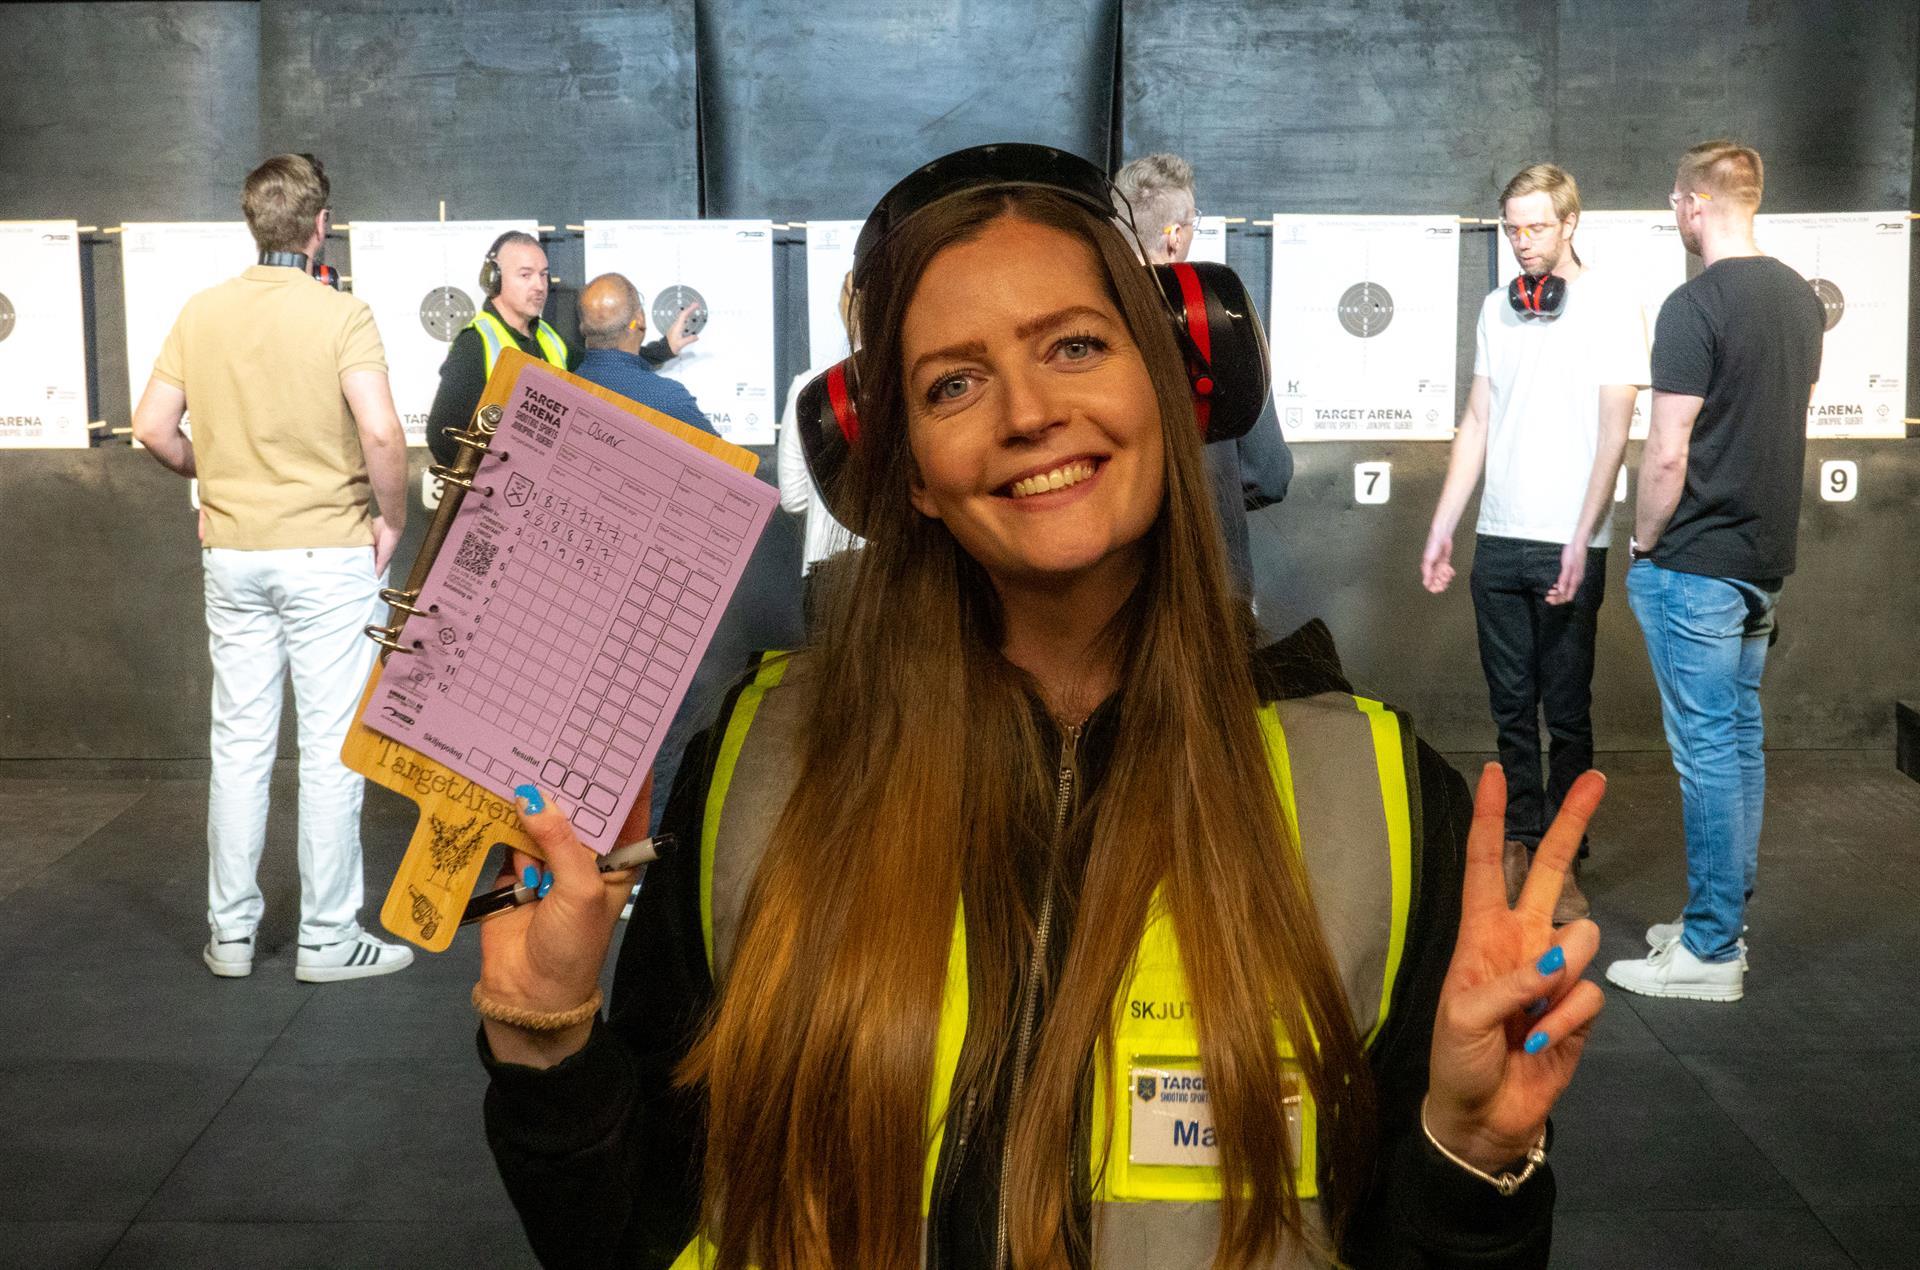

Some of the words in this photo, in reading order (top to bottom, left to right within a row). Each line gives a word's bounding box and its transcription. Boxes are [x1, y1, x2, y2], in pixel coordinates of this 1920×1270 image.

[525, 387, 568, 416] TARGET
[520, 401, 560, 428] ARENA
[1315, 409, 1365, 420] TARGET
[1367, 409, 1413, 420] ARENA
[1818, 404, 1863, 416] ARENA
[404, 413, 430, 424] TAR
[704, 412, 732, 423] ENA
[587, 421, 625, 448] Oscar
[1363, 471, 1381, 496] 7
[1830, 468, 1848, 493] 9
[431, 478, 445, 502] 3
[532, 492, 538, 500] 1
[523, 509, 531, 519] 2
[544, 495, 553, 508] 8
[559, 502, 569, 516] 7
[579, 510, 592, 525] 7
[594, 521, 605, 533] 7
[609, 529, 621, 544] 7
[514, 527, 522, 536] 3
[551, 521, 561, 533] 8
[567, 529, 574, 542] 8
[585, 539, 594, 552] 7
[601, 548, 617, 564] 7
[507, 545, 514, 554] 4
[499, 562, 506, 571] 5
[576, 558, 585, 570] 9
[589, 566, 603, 583] 7
[491, 580, 498, 589] 6
[482, 597, 490, 605] 7
[474, 615, 482, 624] 8
[466, 632, 473, 641] 9
[454, 648, 465, 658] 10
[445, 665, 456, 675] 11
[437, 682, 448, 693] 12
[423, 733, 463, 760] Skiljepoäng
[512, 747, 540, 767] Resultat
[1161, 1077, 1208, 1090] TARG
